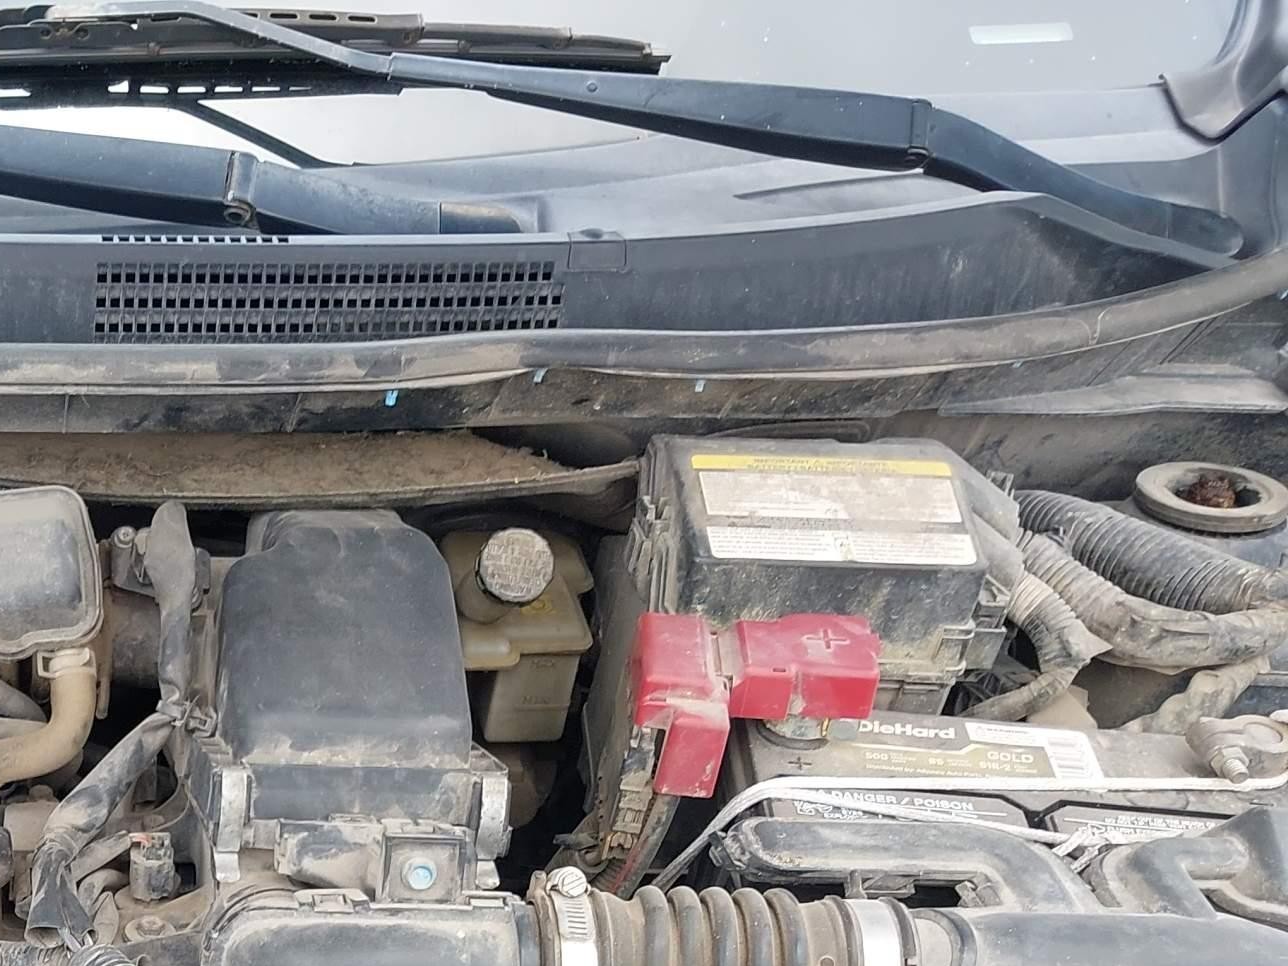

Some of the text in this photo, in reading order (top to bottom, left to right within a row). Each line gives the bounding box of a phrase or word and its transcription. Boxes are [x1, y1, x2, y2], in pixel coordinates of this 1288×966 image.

[858, 720, 956, 739] DieHard
[987, 751, 1034, 764] GOLD
[831, 791, 897, 804] DANGER
[914, 797, 974, 811] POISON
